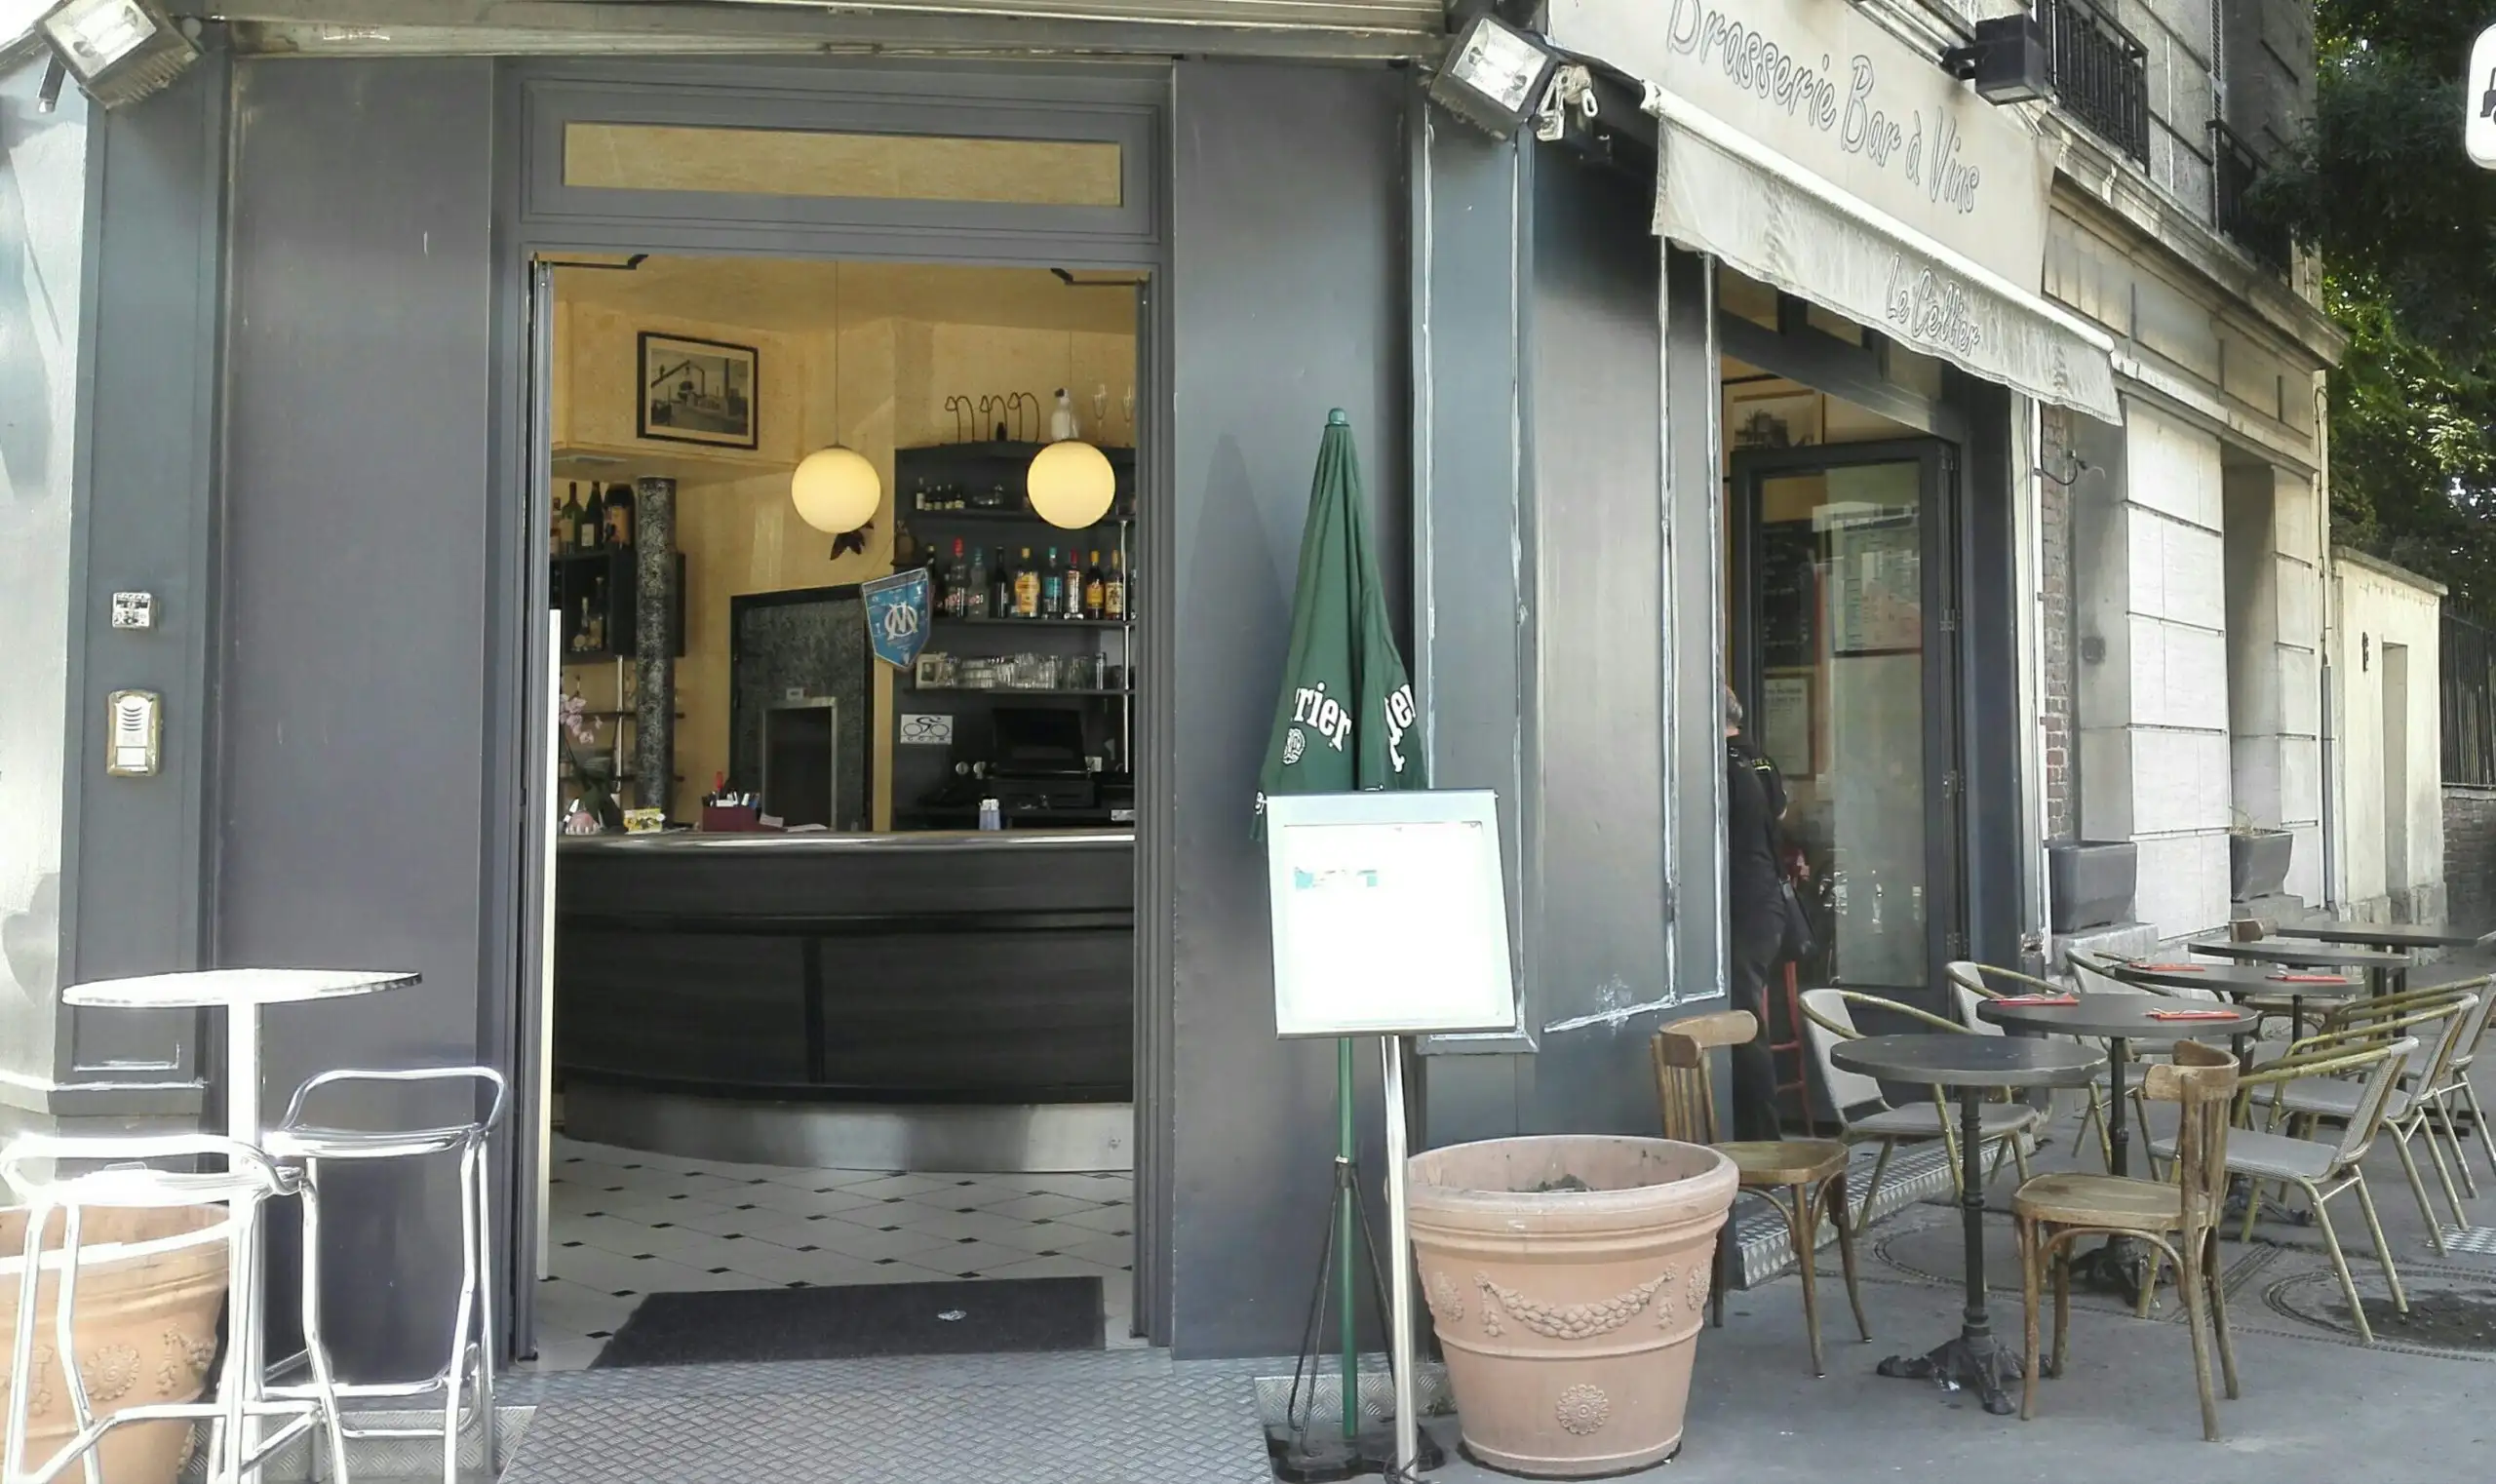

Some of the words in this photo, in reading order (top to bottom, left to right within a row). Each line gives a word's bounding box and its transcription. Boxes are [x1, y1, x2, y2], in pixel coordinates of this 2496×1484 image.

[1841, 55, 1901, 168] Bar
[1905, 109, 1922, 186] à
[1930, 105, 1980, 215] Vins
[1887, 253, 1911, 325] Le
[1912, 267, 1980, 357] Cellier
[1294, 682, 1352, 752] rier
